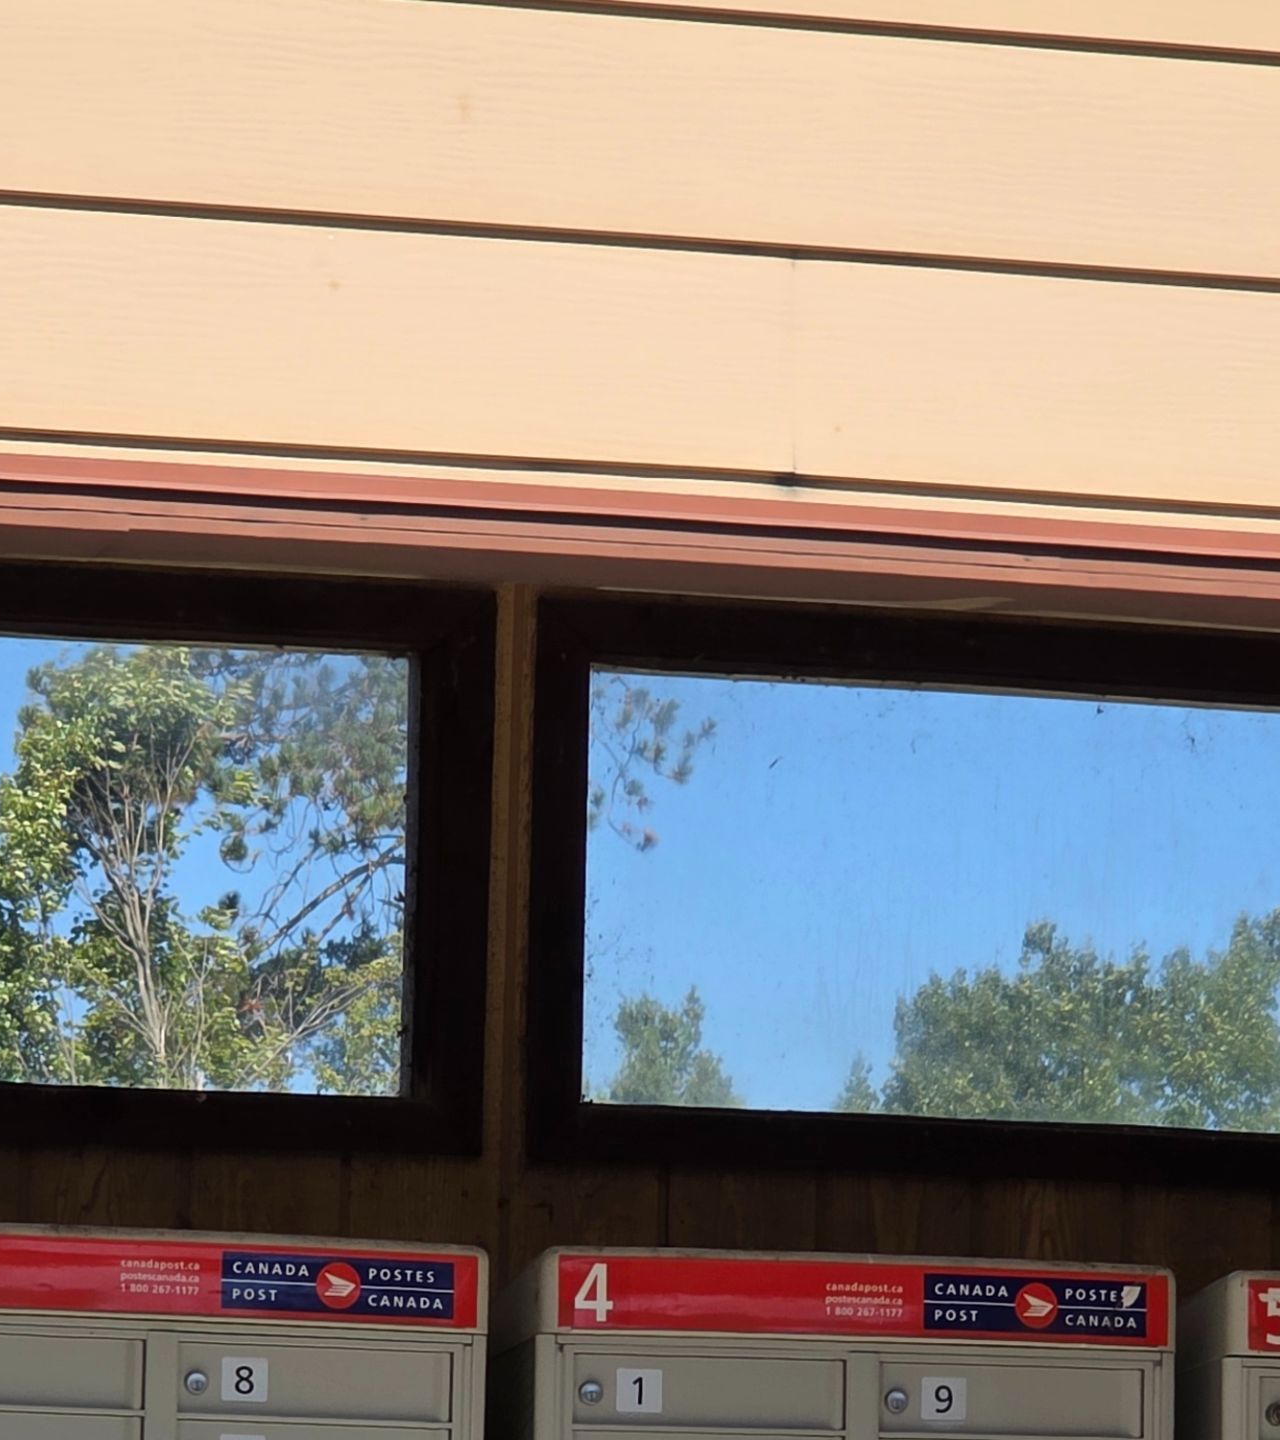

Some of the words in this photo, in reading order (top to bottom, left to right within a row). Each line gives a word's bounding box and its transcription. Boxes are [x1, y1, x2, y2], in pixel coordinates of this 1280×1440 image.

[120, 1259, 201, 1272] canadapost.ca
[232, 1261, 310, 1277] CANADA
[368, 1267, 436, 1283] POSTES
[129, 1283, 149, 1294] 800
[152, 1284, 200, 1295] 267-1177
[232, 1288, 278, 1301] POST
[573, 1262, 614, 1323] 4
[825, 1281, 904, 1294] canadapost.ca
[934, 1283, 1009, 1298] CANADA
[367, 1294, 444, 1310] CANADA
[1065, 1288, 1127, 1303] POSTE
[835, 1306, 854, 1317] 800
[856, 1307, 903, 1318] 267-1177
[934, 1309, 979, 1322] POST
[1065, 1315, 1138, 1329] CANADA
[234, 1365, 255, 1395] 8
[632, 1376, 643, 1406] 1
[934, 1384, 953, 1414] 9
